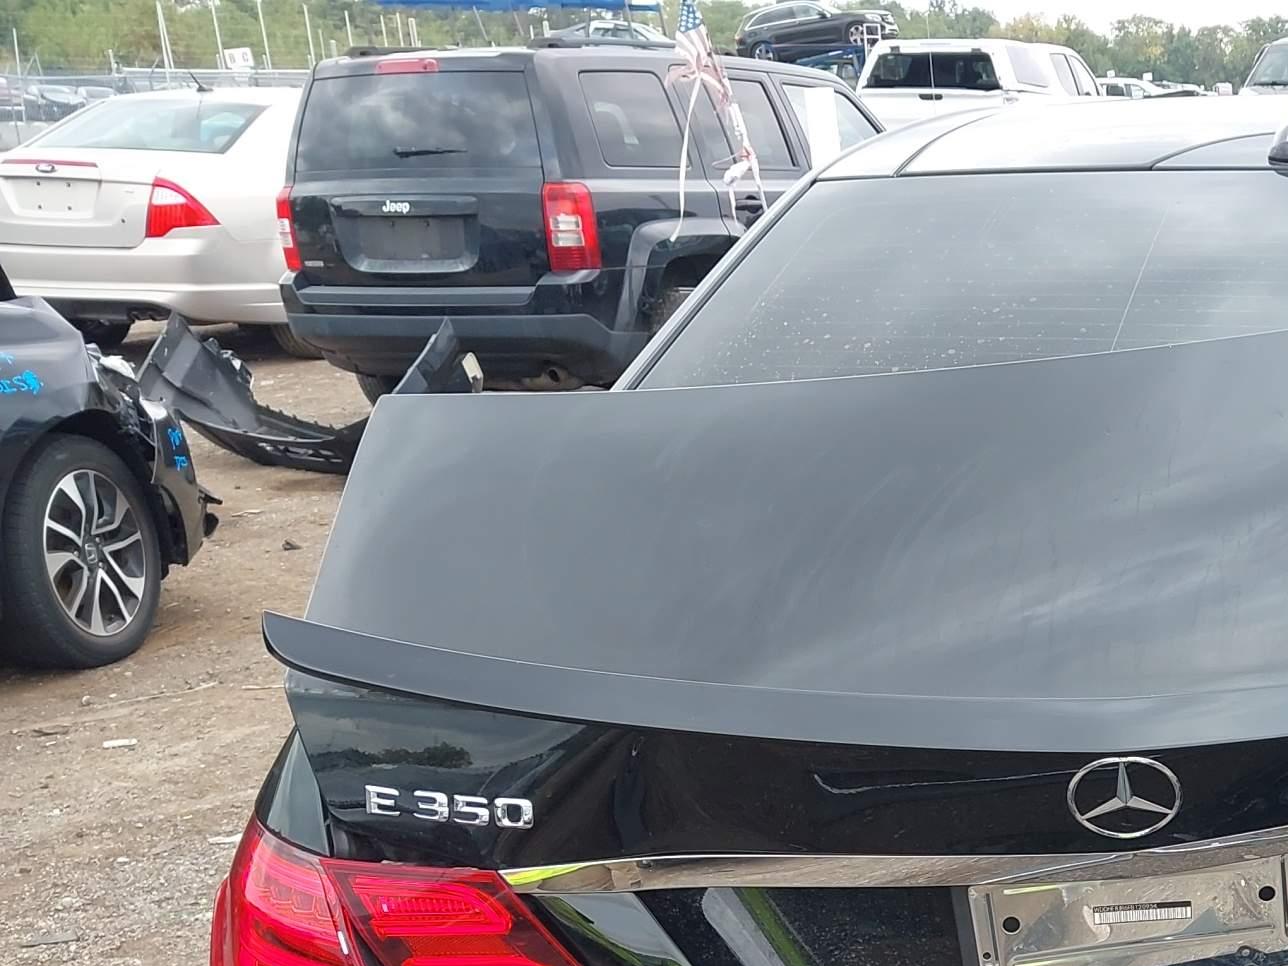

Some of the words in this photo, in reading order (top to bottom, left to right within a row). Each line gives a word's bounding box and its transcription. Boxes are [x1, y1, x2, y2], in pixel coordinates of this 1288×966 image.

[382, 199, 411, 214] Jeep
[364, 784, 401, 817] E
[412, 789, 534, 830] 350
